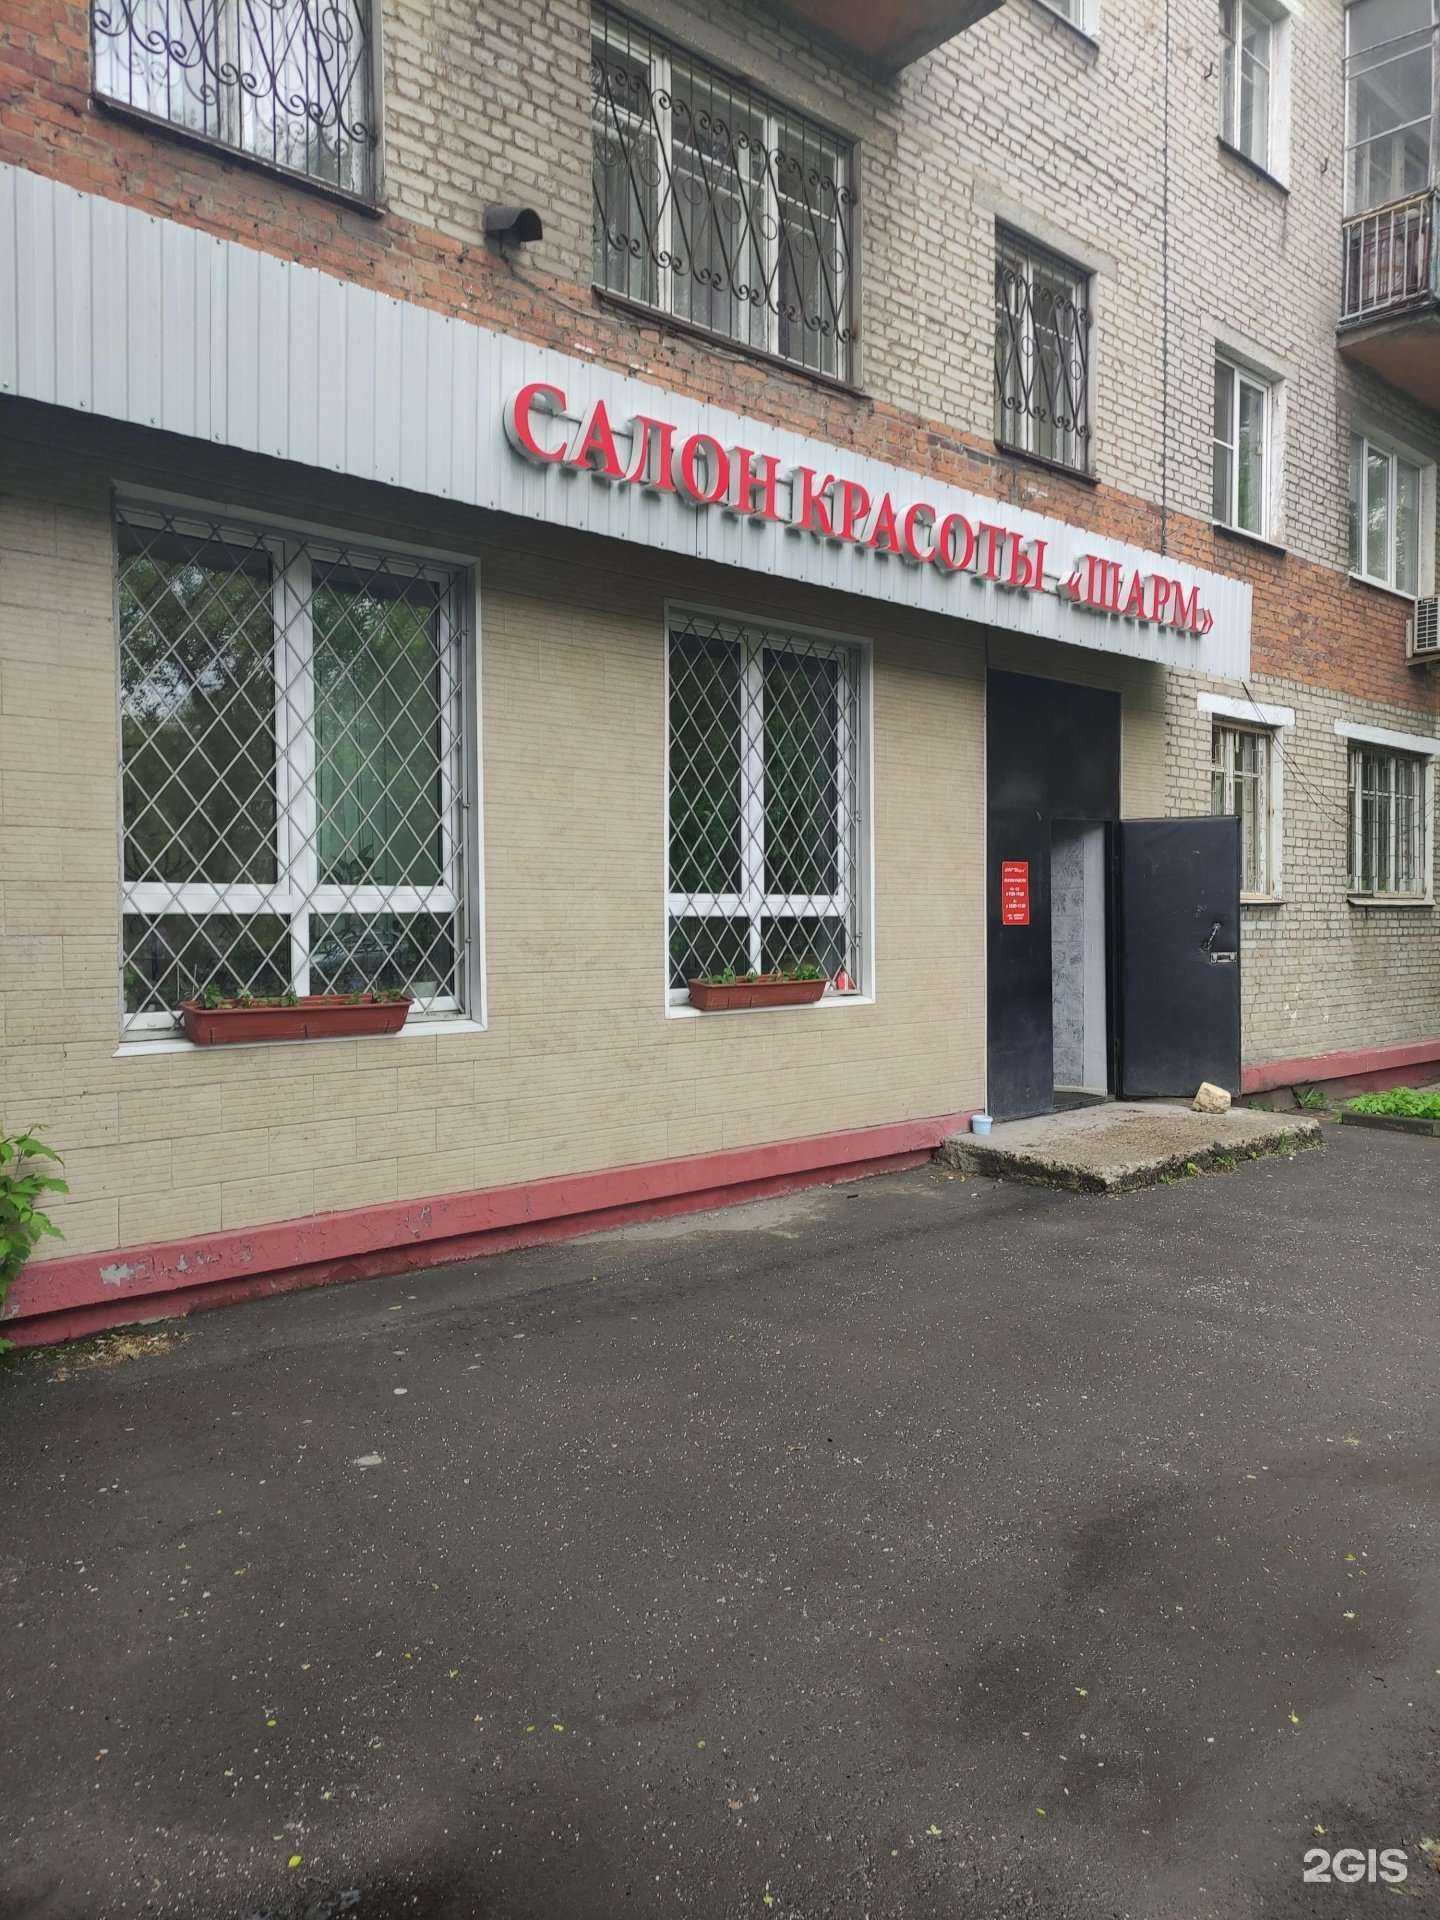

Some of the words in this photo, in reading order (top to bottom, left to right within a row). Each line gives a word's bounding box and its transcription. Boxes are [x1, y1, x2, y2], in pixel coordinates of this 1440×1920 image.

[508, 382, 781, 522] САЛОН
[796, 466, 1048, 592] КРАСОТЫ
[1060, 553, 1214, 636] «ШАРМ»
